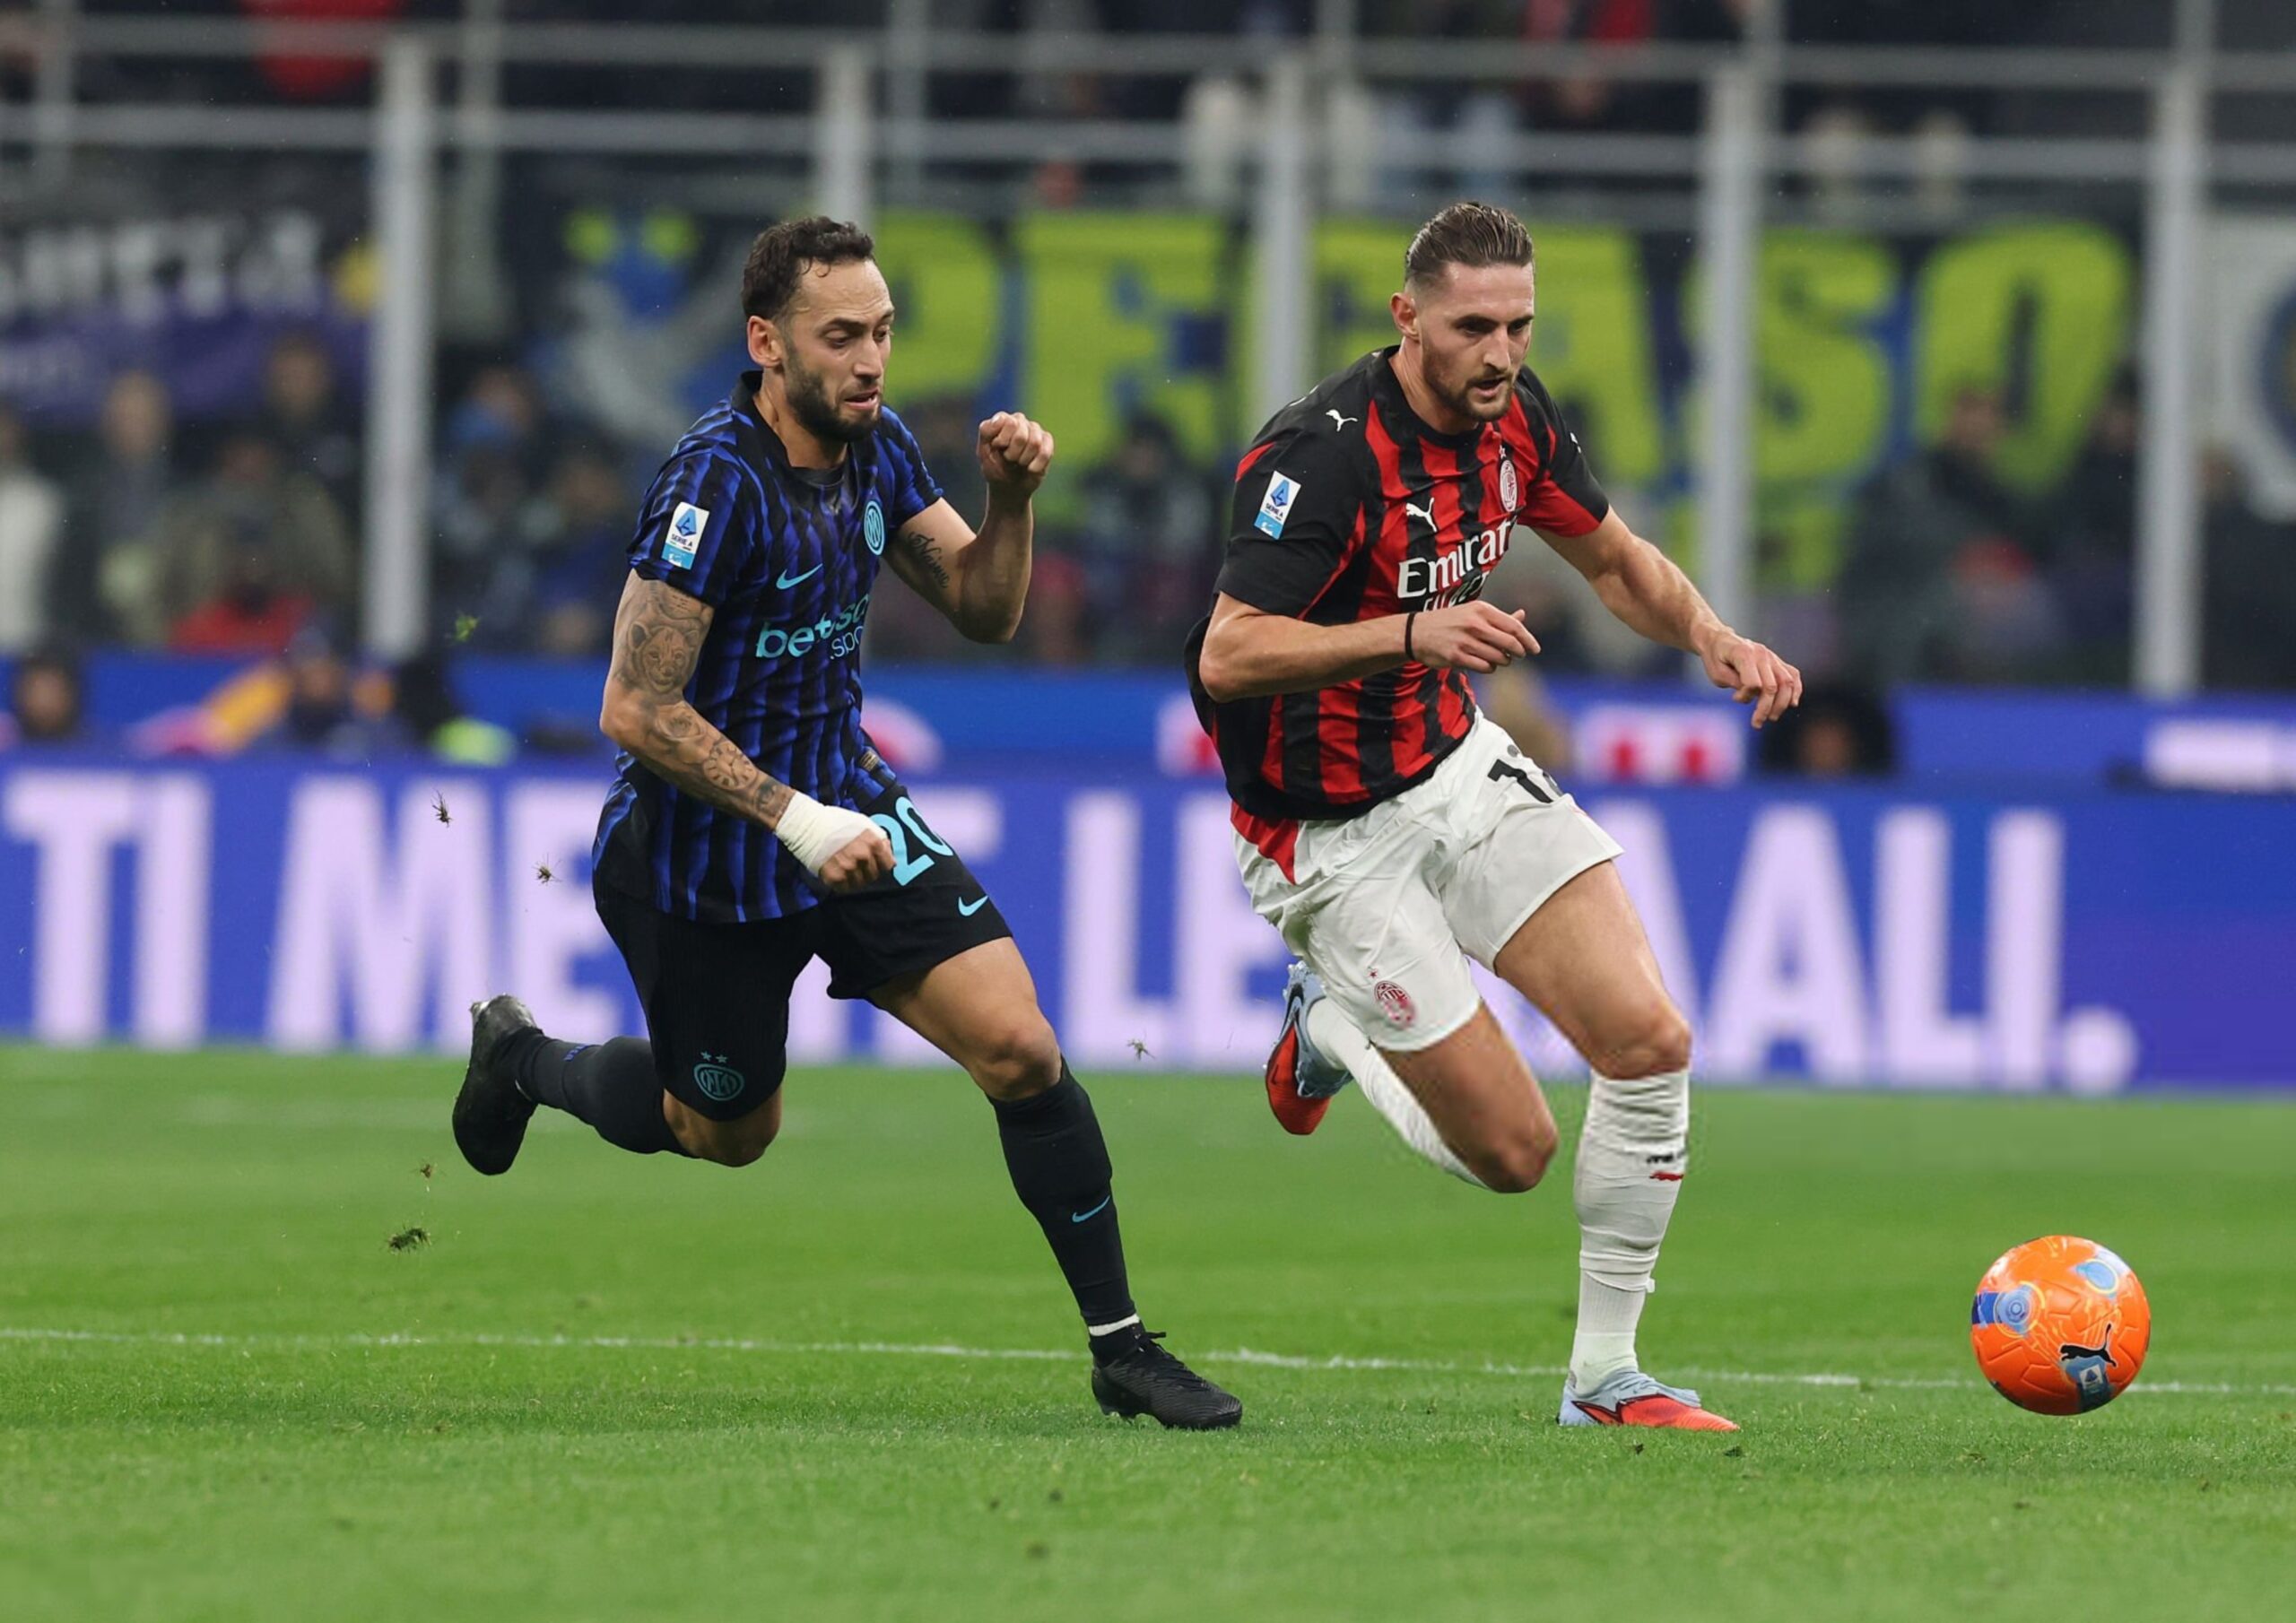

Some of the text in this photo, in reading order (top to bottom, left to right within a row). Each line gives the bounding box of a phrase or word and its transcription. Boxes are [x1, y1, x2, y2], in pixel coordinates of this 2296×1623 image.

[671, 534, 687, 545] SERIE
[4, 769, 213, 1053] TI
[1060, 787, 1290, 1069] LE
